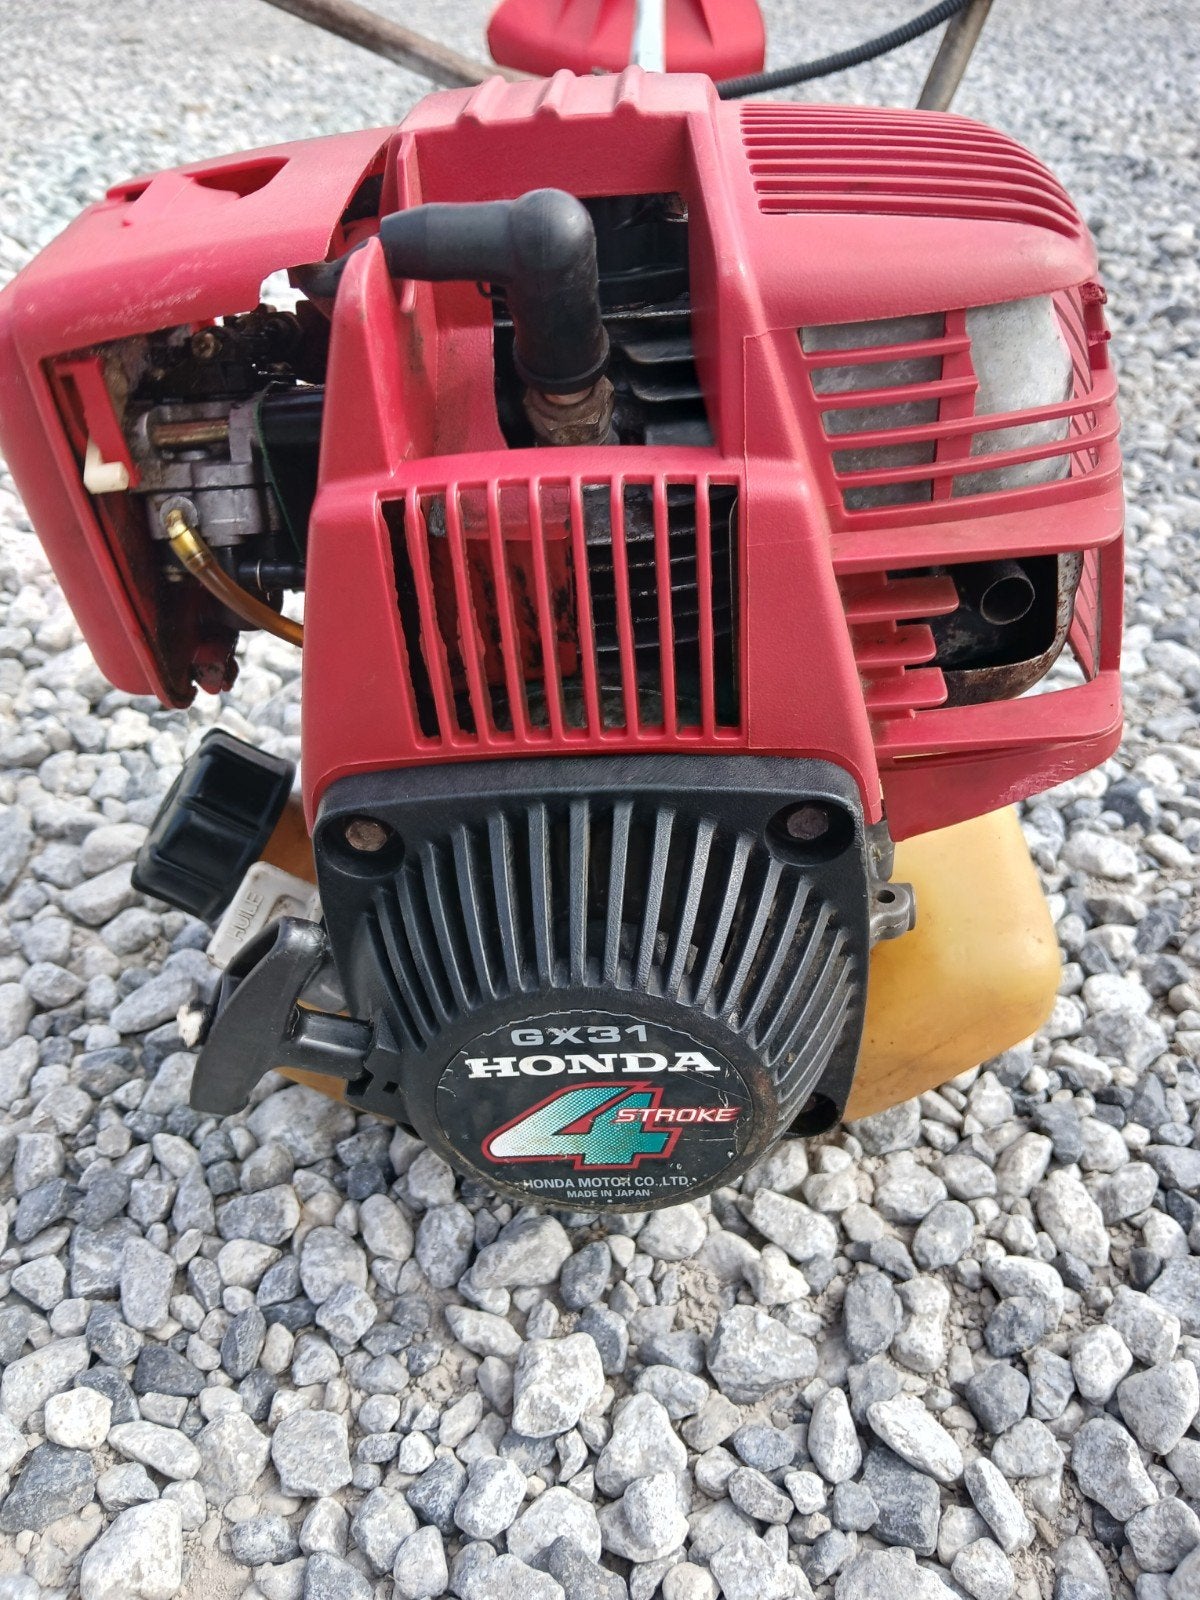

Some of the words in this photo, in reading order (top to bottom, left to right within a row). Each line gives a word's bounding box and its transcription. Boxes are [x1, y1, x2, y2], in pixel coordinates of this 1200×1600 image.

[226, 891, 264, 942] HUILE
[510, 1024, 648, 1047] GX31
[464, 1051, 721, 1079] HONDA
[481, 1080, 683, 1170] 4
[613, 1107, 739, 1123] STROKE
[524, 1178, 575, 1189] HONDA
[578, 1176, 631, 1188] MOTOR
[566, 1189, 599, 1198] MADE
[600, 1189, 612, 1197] IN
[614, 1188, 651, 1197] JAPAN
